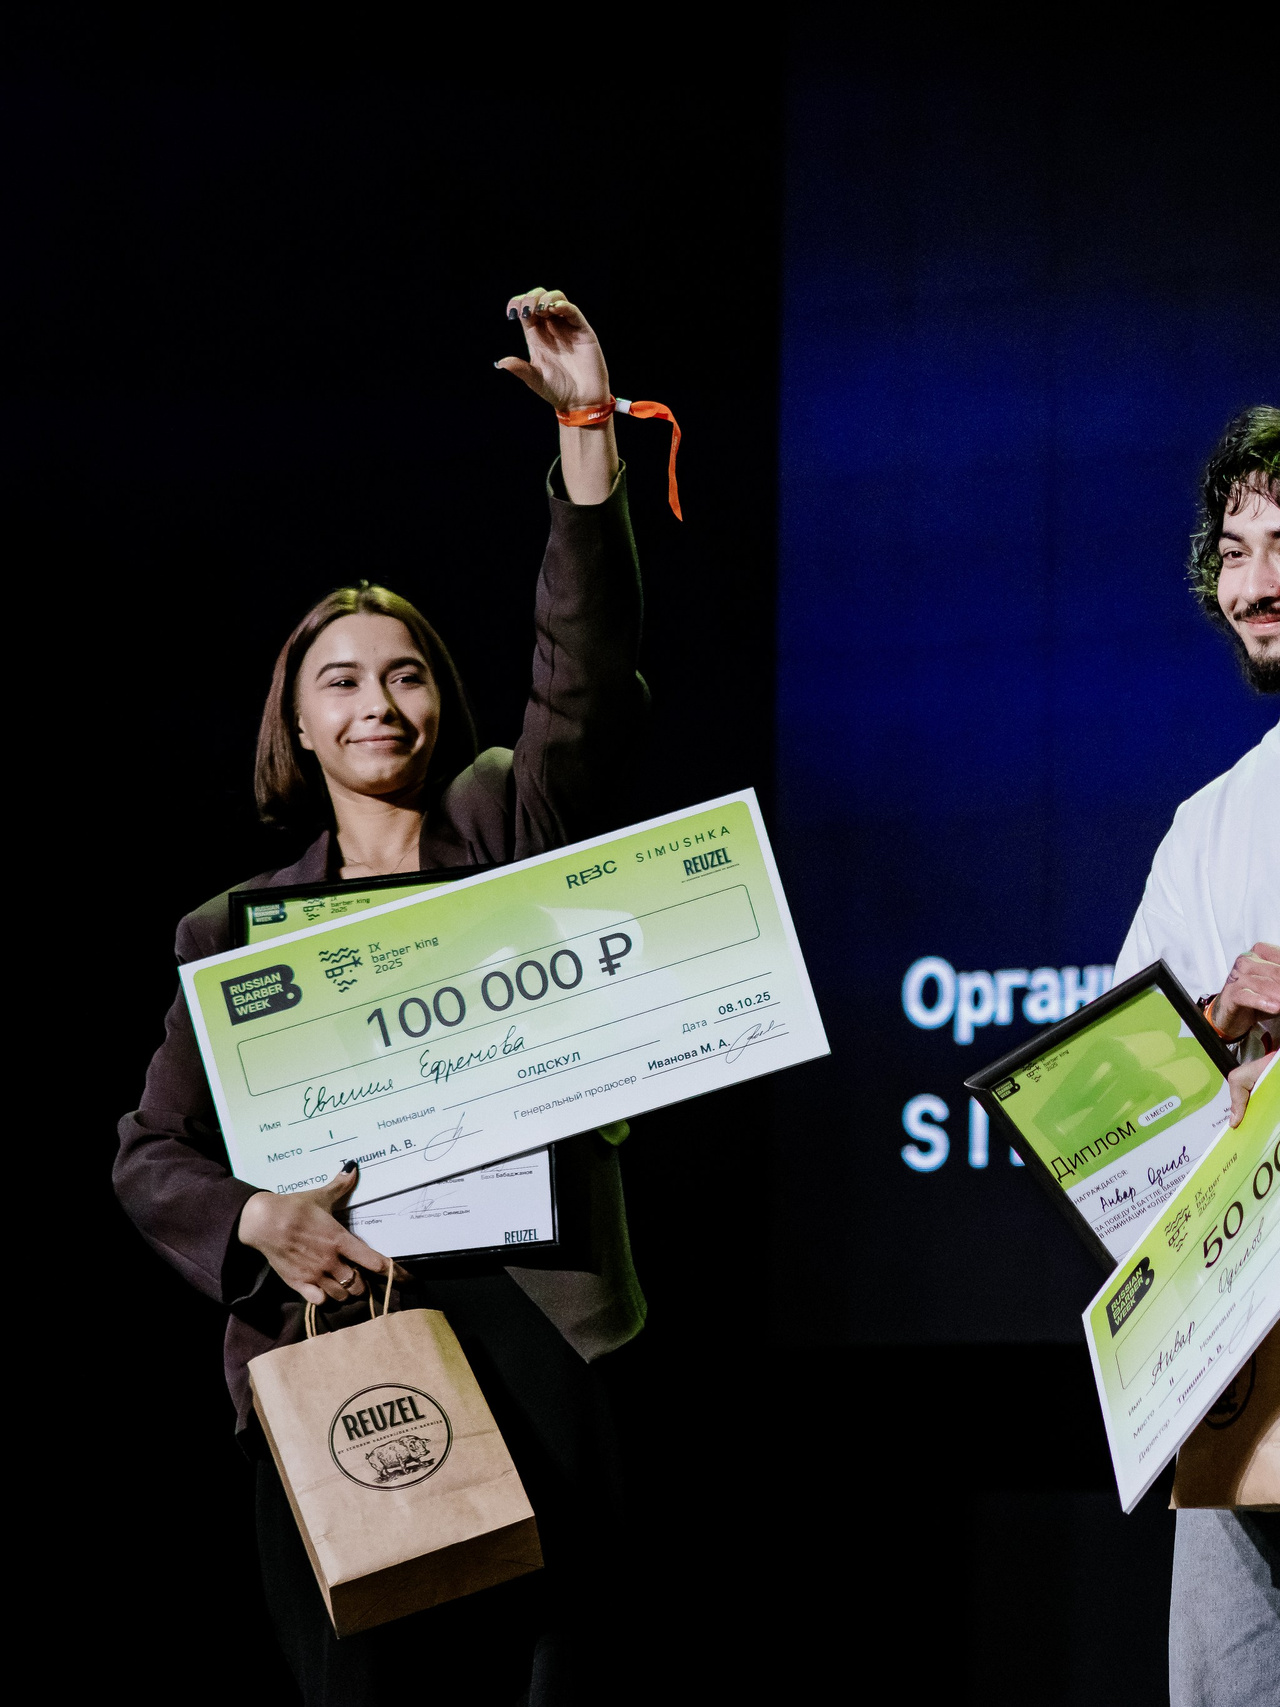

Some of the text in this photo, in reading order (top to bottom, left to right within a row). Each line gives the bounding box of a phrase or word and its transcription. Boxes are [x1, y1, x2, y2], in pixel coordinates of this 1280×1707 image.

[636, 826, 730, 863] SIMUSHKA
[683, 848, 732, 876] REUZEL
[368, 942, 381, 953] IX
[371, 937, 439, 963] barber king
[229, 972, 281, 995] RUSSIAN
[232, 983, 284, 1006] BARBER
[367, 932, 632, 1047] 100 000 ₽
[235, 998, 271, 1016] WEEK
[419, 1025, 529, 1084] Ефремова
[267, 1148, 303, 1163] Место
[377, 1106, 435, 1130] Номинация
[517, 1051, 581, 1079] ОЛДСКУЛ
[682, 1020, 707, 1034] Дата
[718, 991, 771, 1015] 08.10.25
[277, 1174, 328, 1198] Директор
[390, 1144, 402, 1154] А.
[404, 1139, 416, 1149] В.
[513, 1091, 583, 1119] Генеральный
[584, 1075, 637, 1097] продюсер
[648, 1050, 698, 1071] Иванова
[700, 1043, 715, 1054] М.
[719, 1039, 731, 1049] А.
[1150, 1102, 1174, 1118] МЕСТО
[259, 1121, 281, 1132] Имя
[1196, 1153, 1237, 1208] barber king
[1100, 1186, 1136, 1212] Анвар
[1104, 1208, 1130, 1227] ПОБЕДУ
[1136, 1189, 1162, 1208] БАТТЛЕ
[1104, 1207, 1147, 1236] НОМИНАЦИИ
[1203, 1201, 1244, 1268] 50
[505, 1229, 539, 1244] REUZEL
[1111, 1267, 1142, 1312] RUSSIAN
[1113, 1276, 1143, 1319] BARBER
[1114, 1296, 1136, 1325] WEEK
[1207, 1355, 1216, 1367] А.
[341, 1395, 426, 1441] REUZEL
